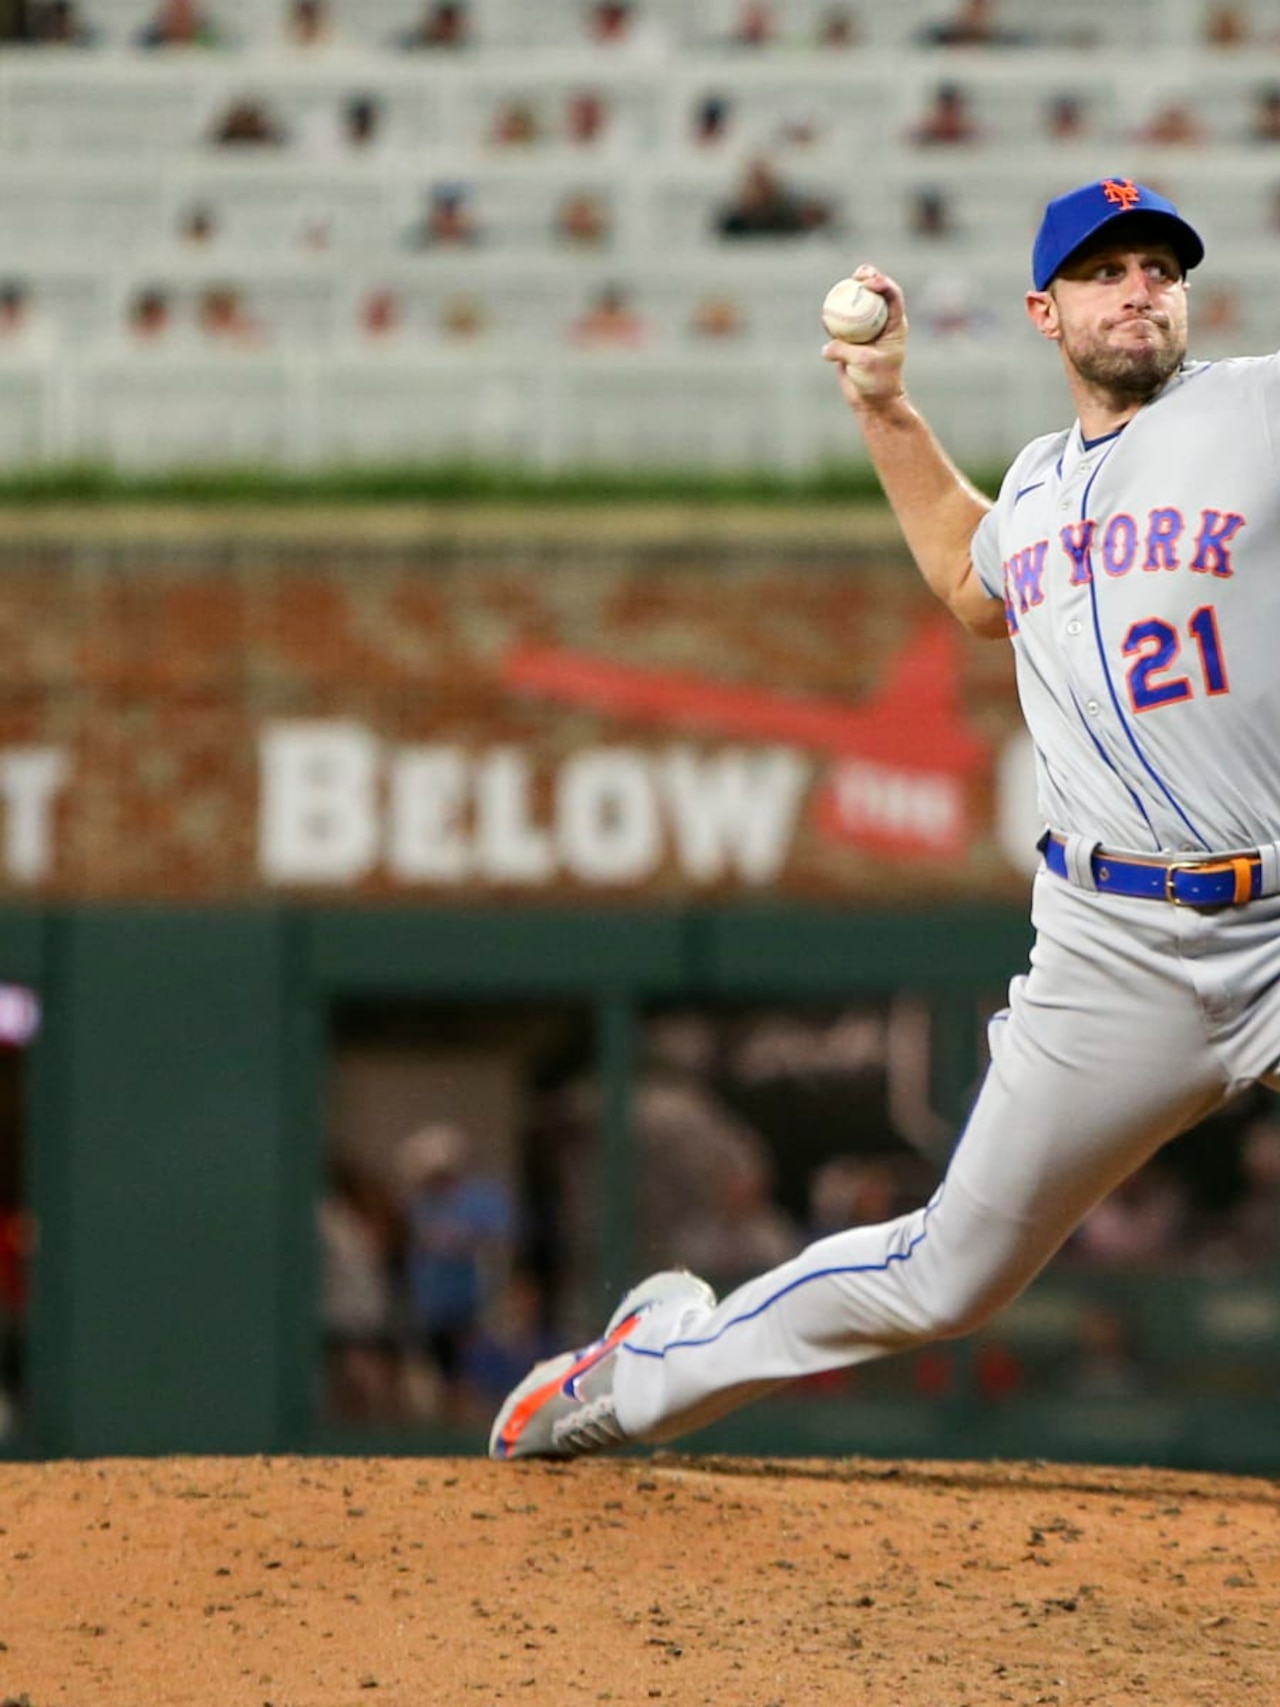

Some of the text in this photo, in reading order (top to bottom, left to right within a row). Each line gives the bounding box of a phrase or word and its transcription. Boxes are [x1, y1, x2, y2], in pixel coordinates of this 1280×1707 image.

[1060, 506, 1246, 587] YORK
[1121, 604, 1230, 714] 21
[257, 719, 810, 884] BELOW
